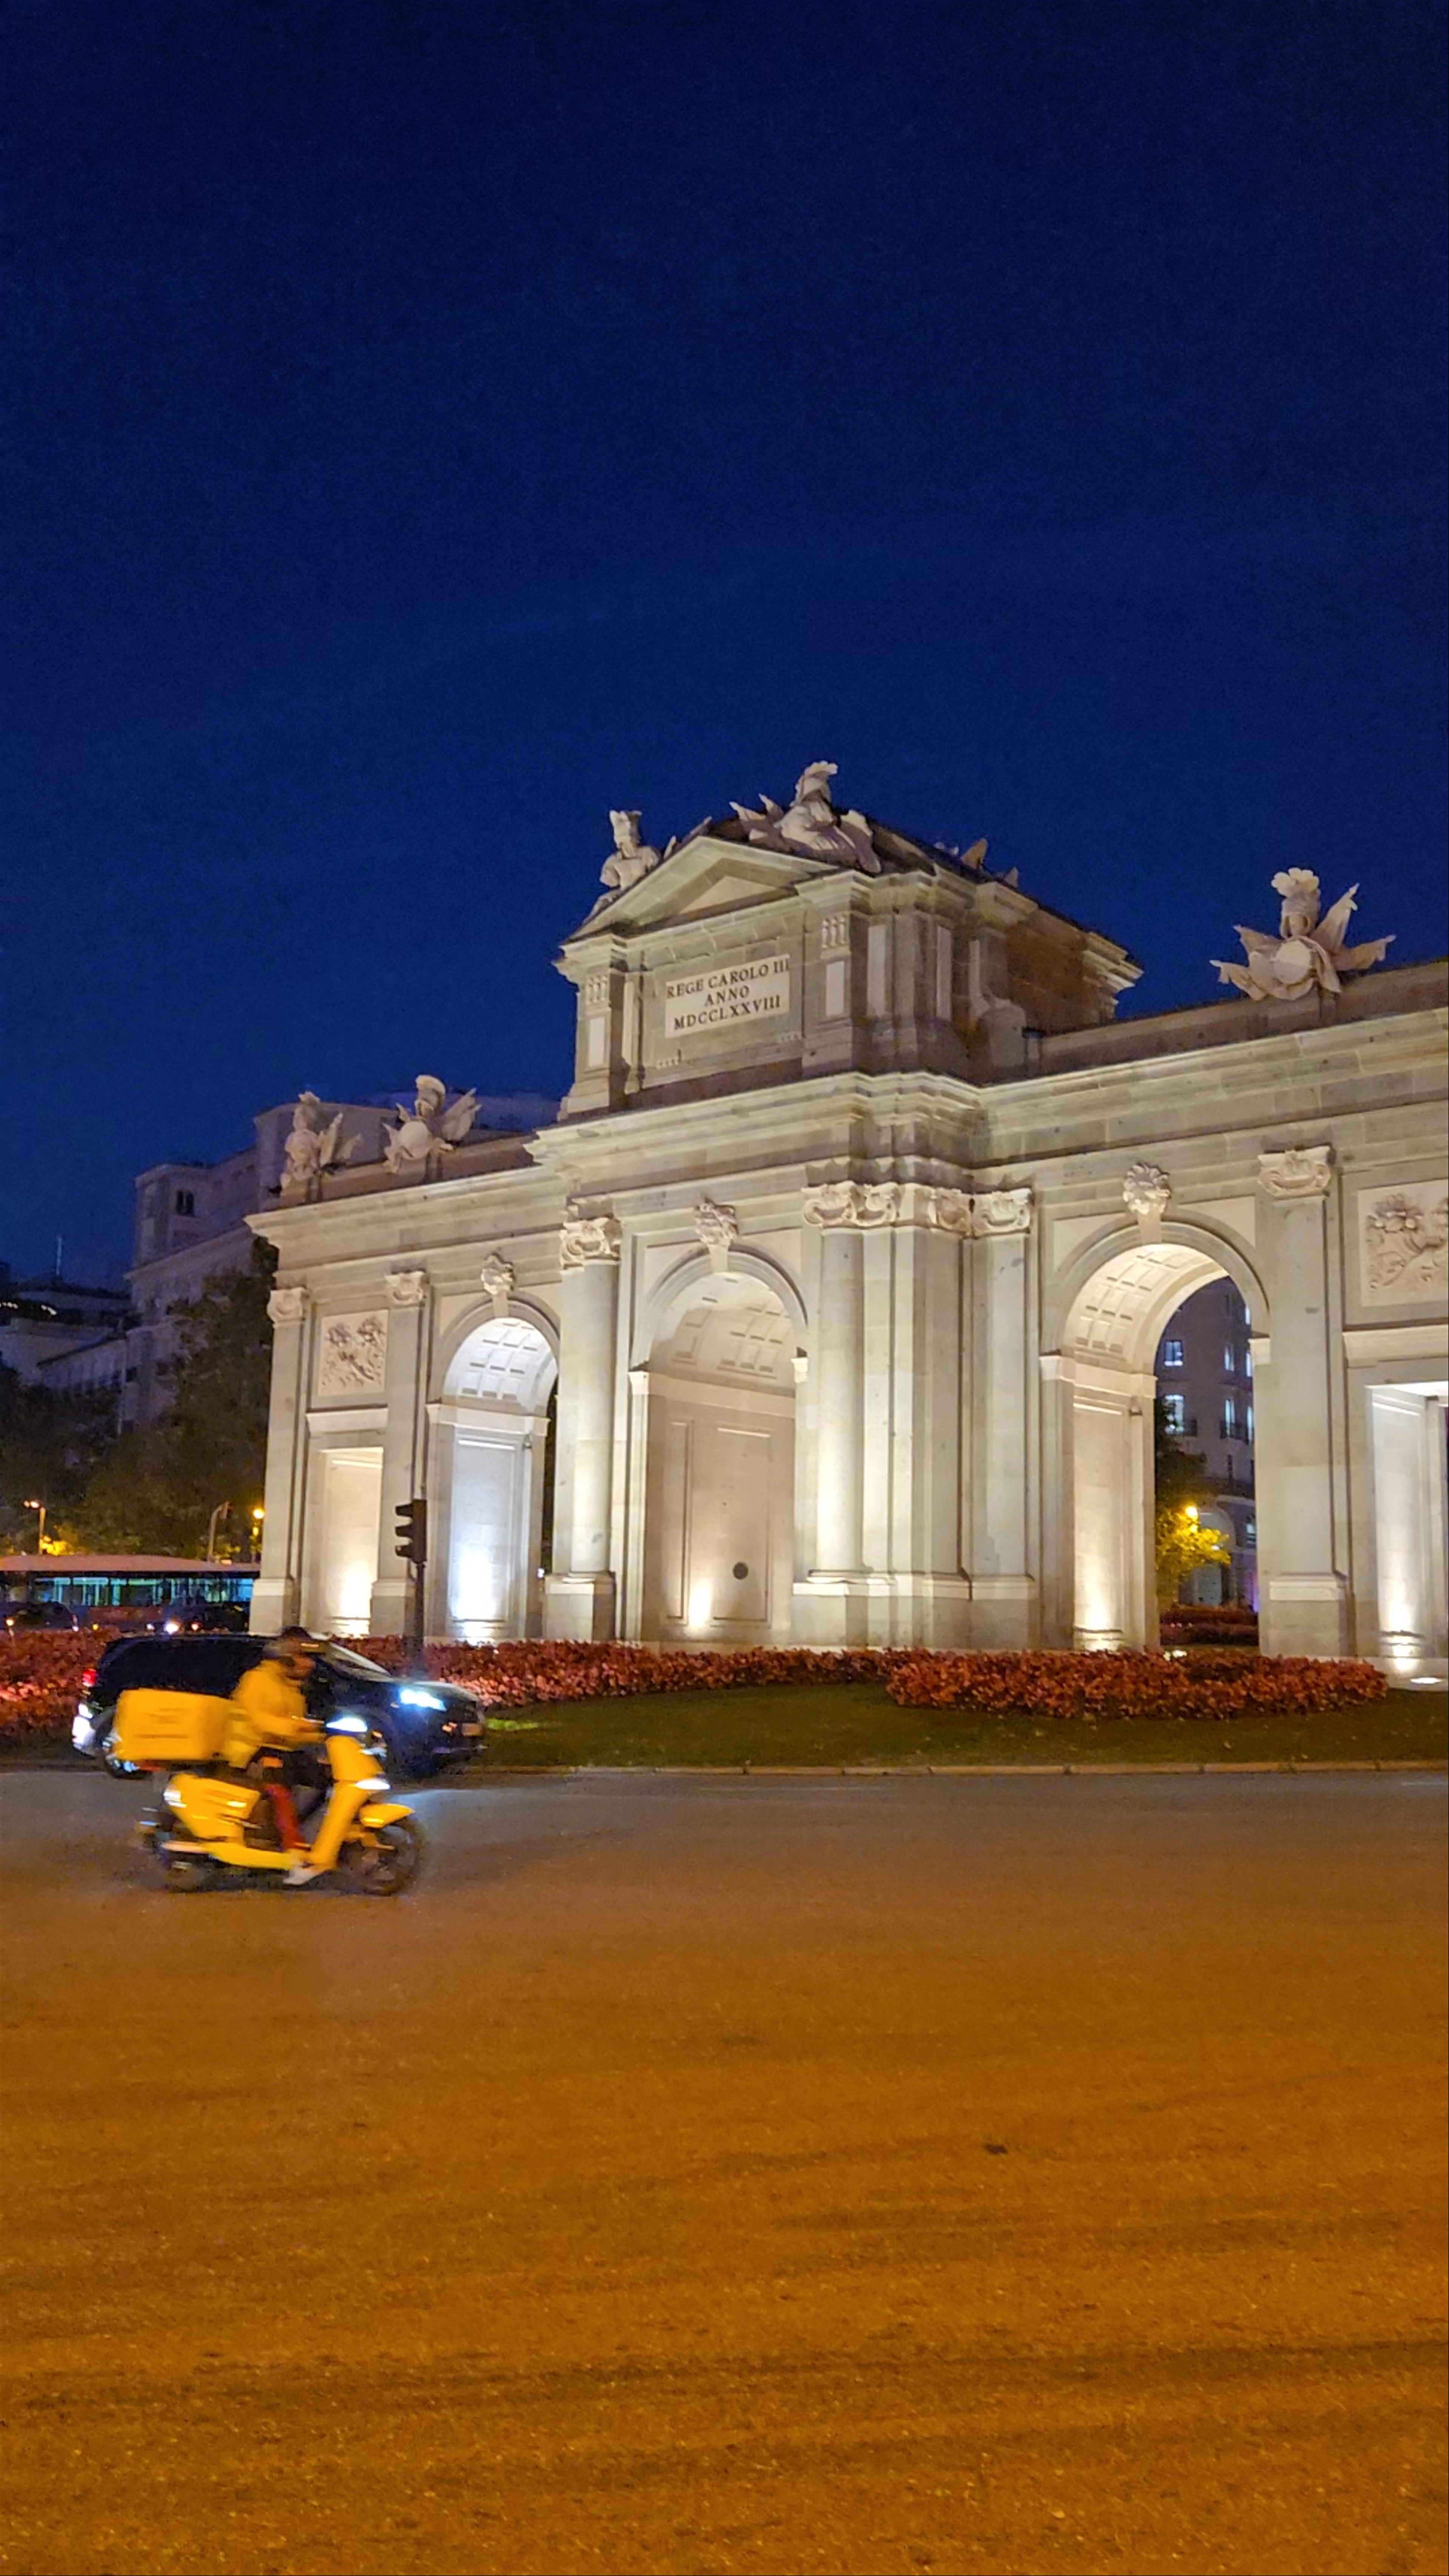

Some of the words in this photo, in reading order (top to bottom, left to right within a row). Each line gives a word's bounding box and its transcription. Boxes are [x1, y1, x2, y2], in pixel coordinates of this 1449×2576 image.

[667, 979, 704, 998] REGE
[708, 964, 769, 989] CAROLO
[774, 959, 790, 973] III
[674, 995, 780, 1030] MDCCLXXVIII
[704, 986, 749, 1007] ANNO
